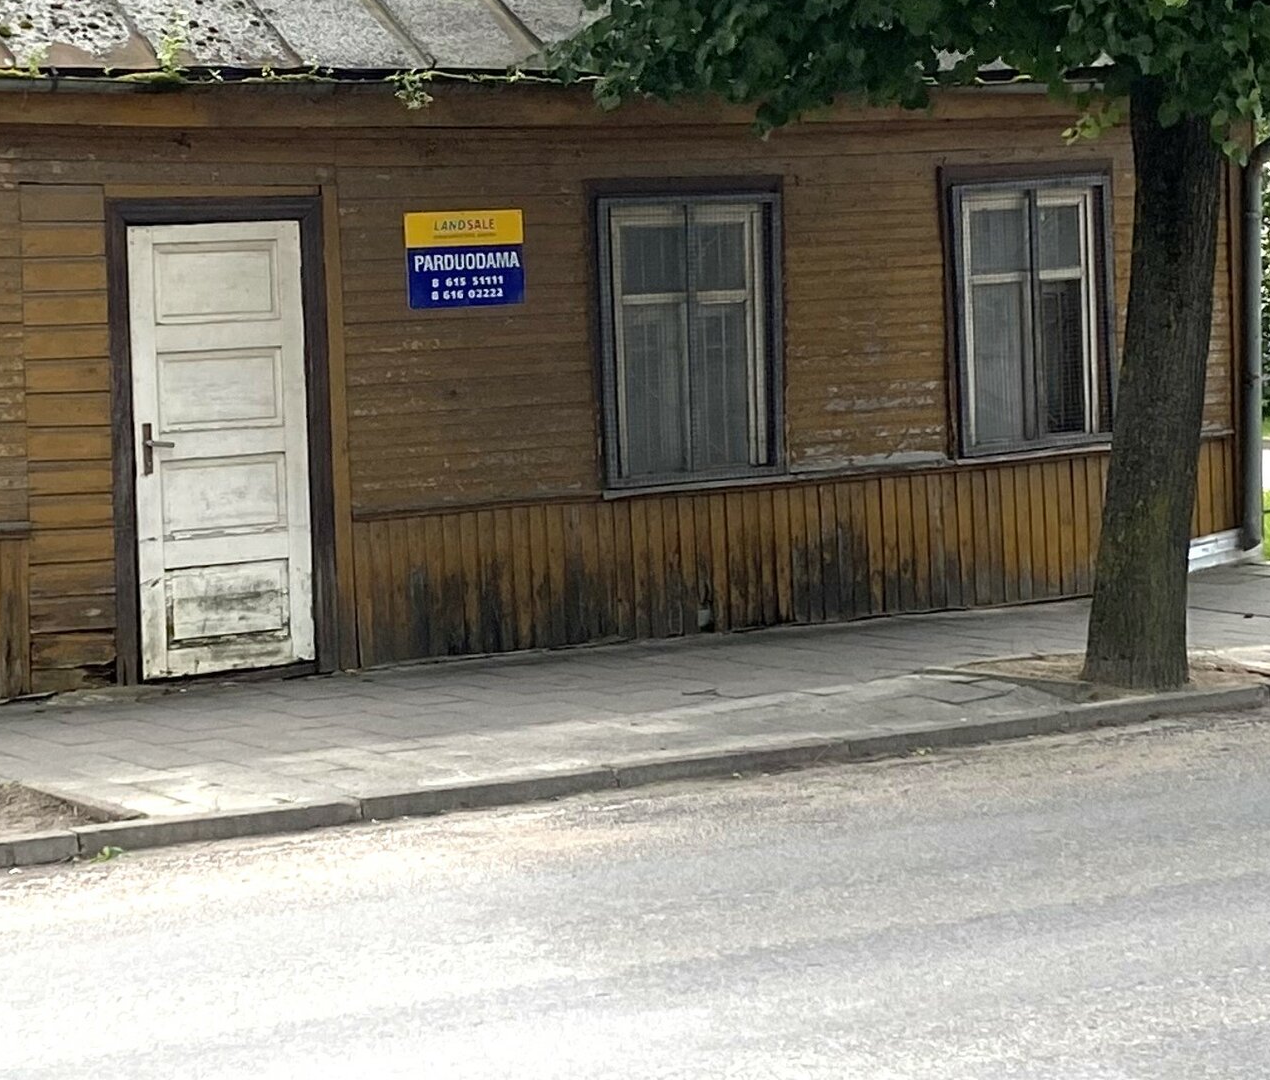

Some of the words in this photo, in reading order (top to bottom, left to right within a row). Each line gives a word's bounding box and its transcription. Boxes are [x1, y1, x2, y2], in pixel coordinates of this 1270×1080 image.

[433, 219, 495, 231] LANDSALE
[414, 251, 520, 272] PARDUODAMA
[432, 278, 439, 288] 8
[445, 277, 466, 287] 615
[472, 275, 504, 286] 51111
[431, 291, 439, 301] 8
[443, 290, 464, 300] 616
[468, 288, 504, 299] 02222
